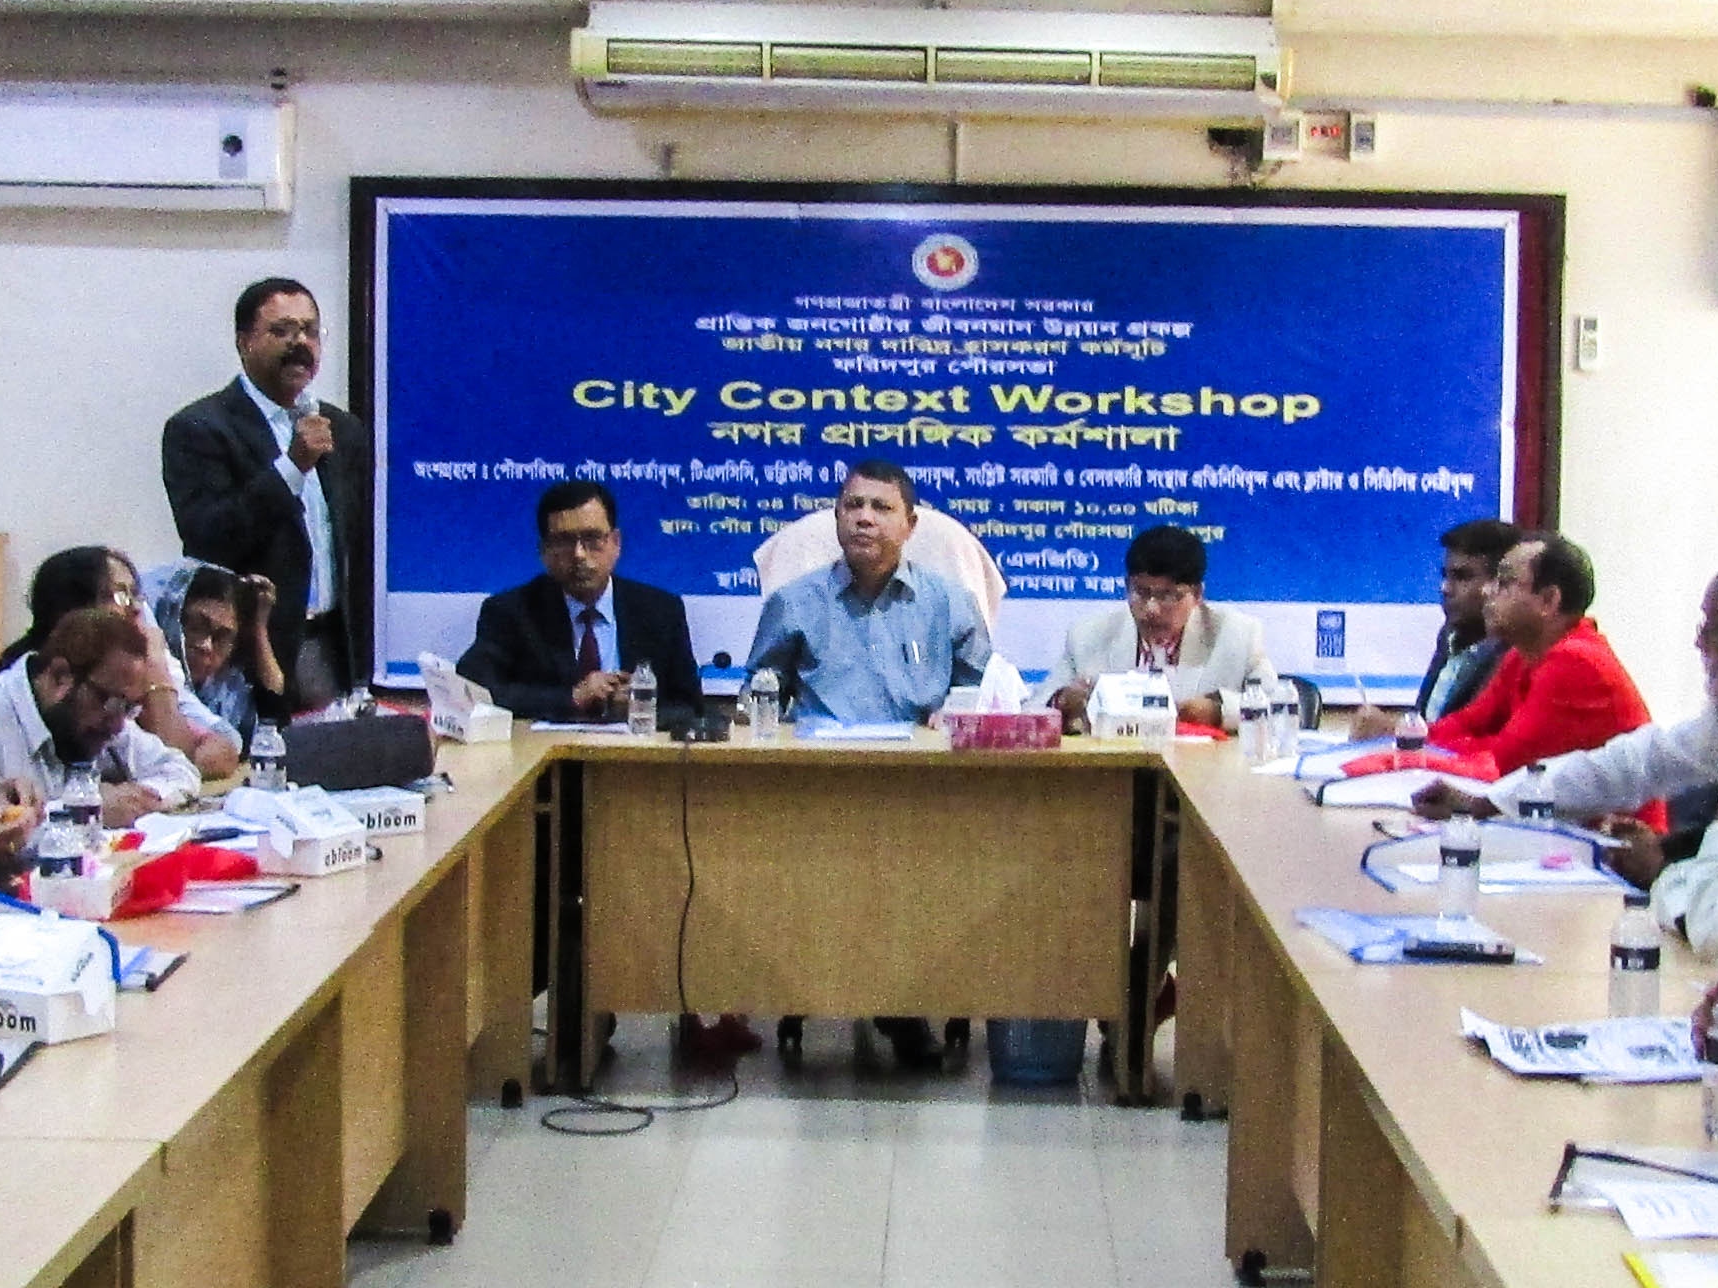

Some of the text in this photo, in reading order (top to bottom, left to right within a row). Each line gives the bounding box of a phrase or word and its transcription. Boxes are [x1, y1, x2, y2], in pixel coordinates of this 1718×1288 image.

[573, 379, 1321, 424] City Context Workshop
[707, 420, 807, 446] নগর
[324, 845, 364, 867] abloom
